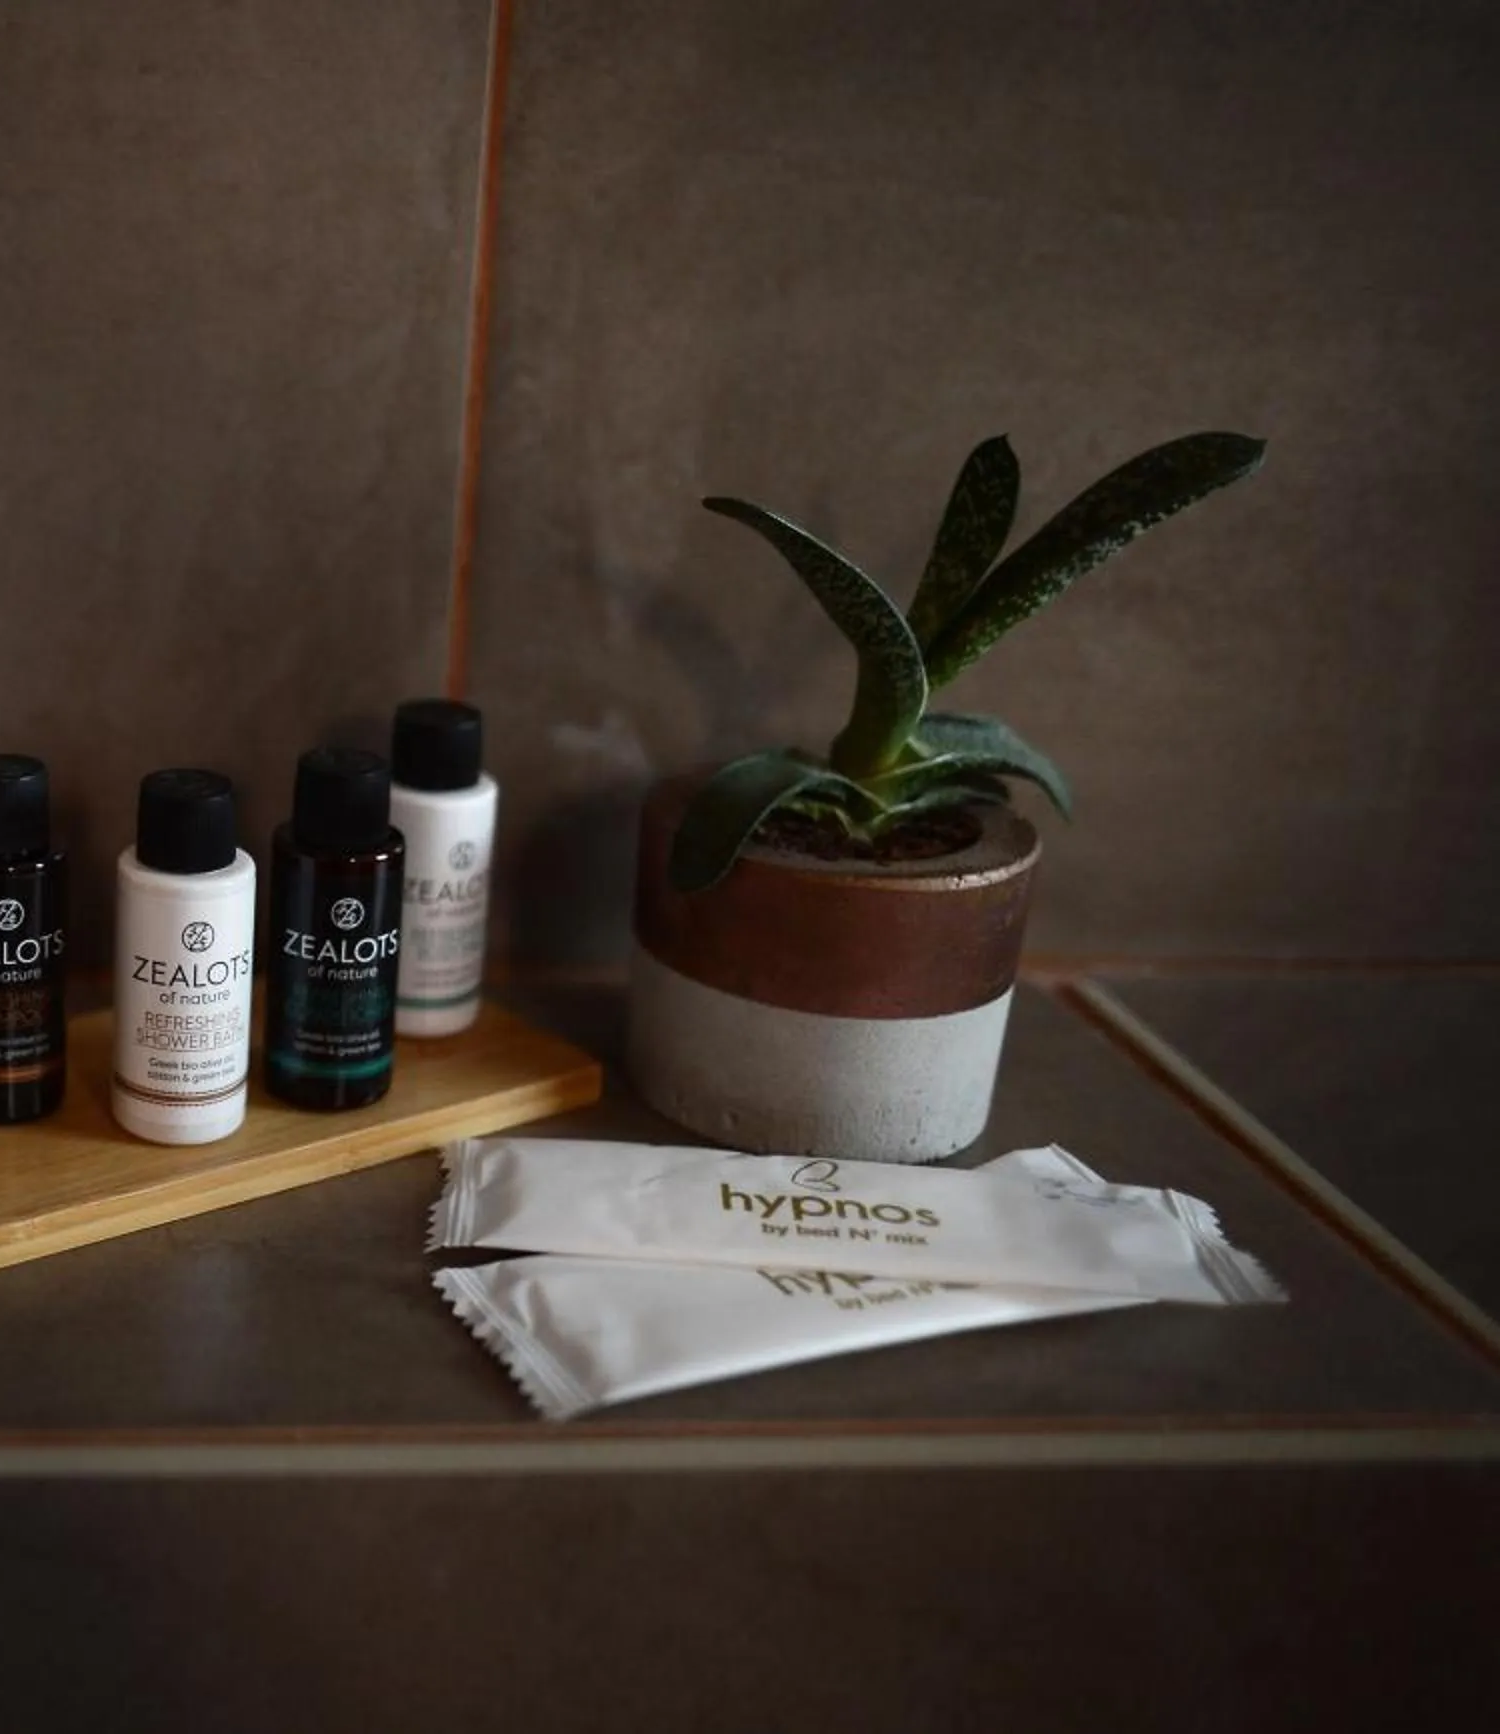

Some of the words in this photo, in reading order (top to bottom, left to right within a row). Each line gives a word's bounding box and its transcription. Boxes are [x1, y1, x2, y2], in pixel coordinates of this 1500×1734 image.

[283, 928, 398, 964] ZEALOTS
[132, 950, 250, 988] ZEALOTS
[308, 965, 326, 979] of
[327, 965, 379, 982] nature
[159, 991, 178, 1004] of
[179, 989, 231, 1005] nature
[720, 1183, 941, 1228] hypnos
[761, 1223, 789, 1237] by
[796, 1224, 840, 1238] bed
[886, 1233, 929, 1246] mix
[755, 1268, 876, 1297] hyp
